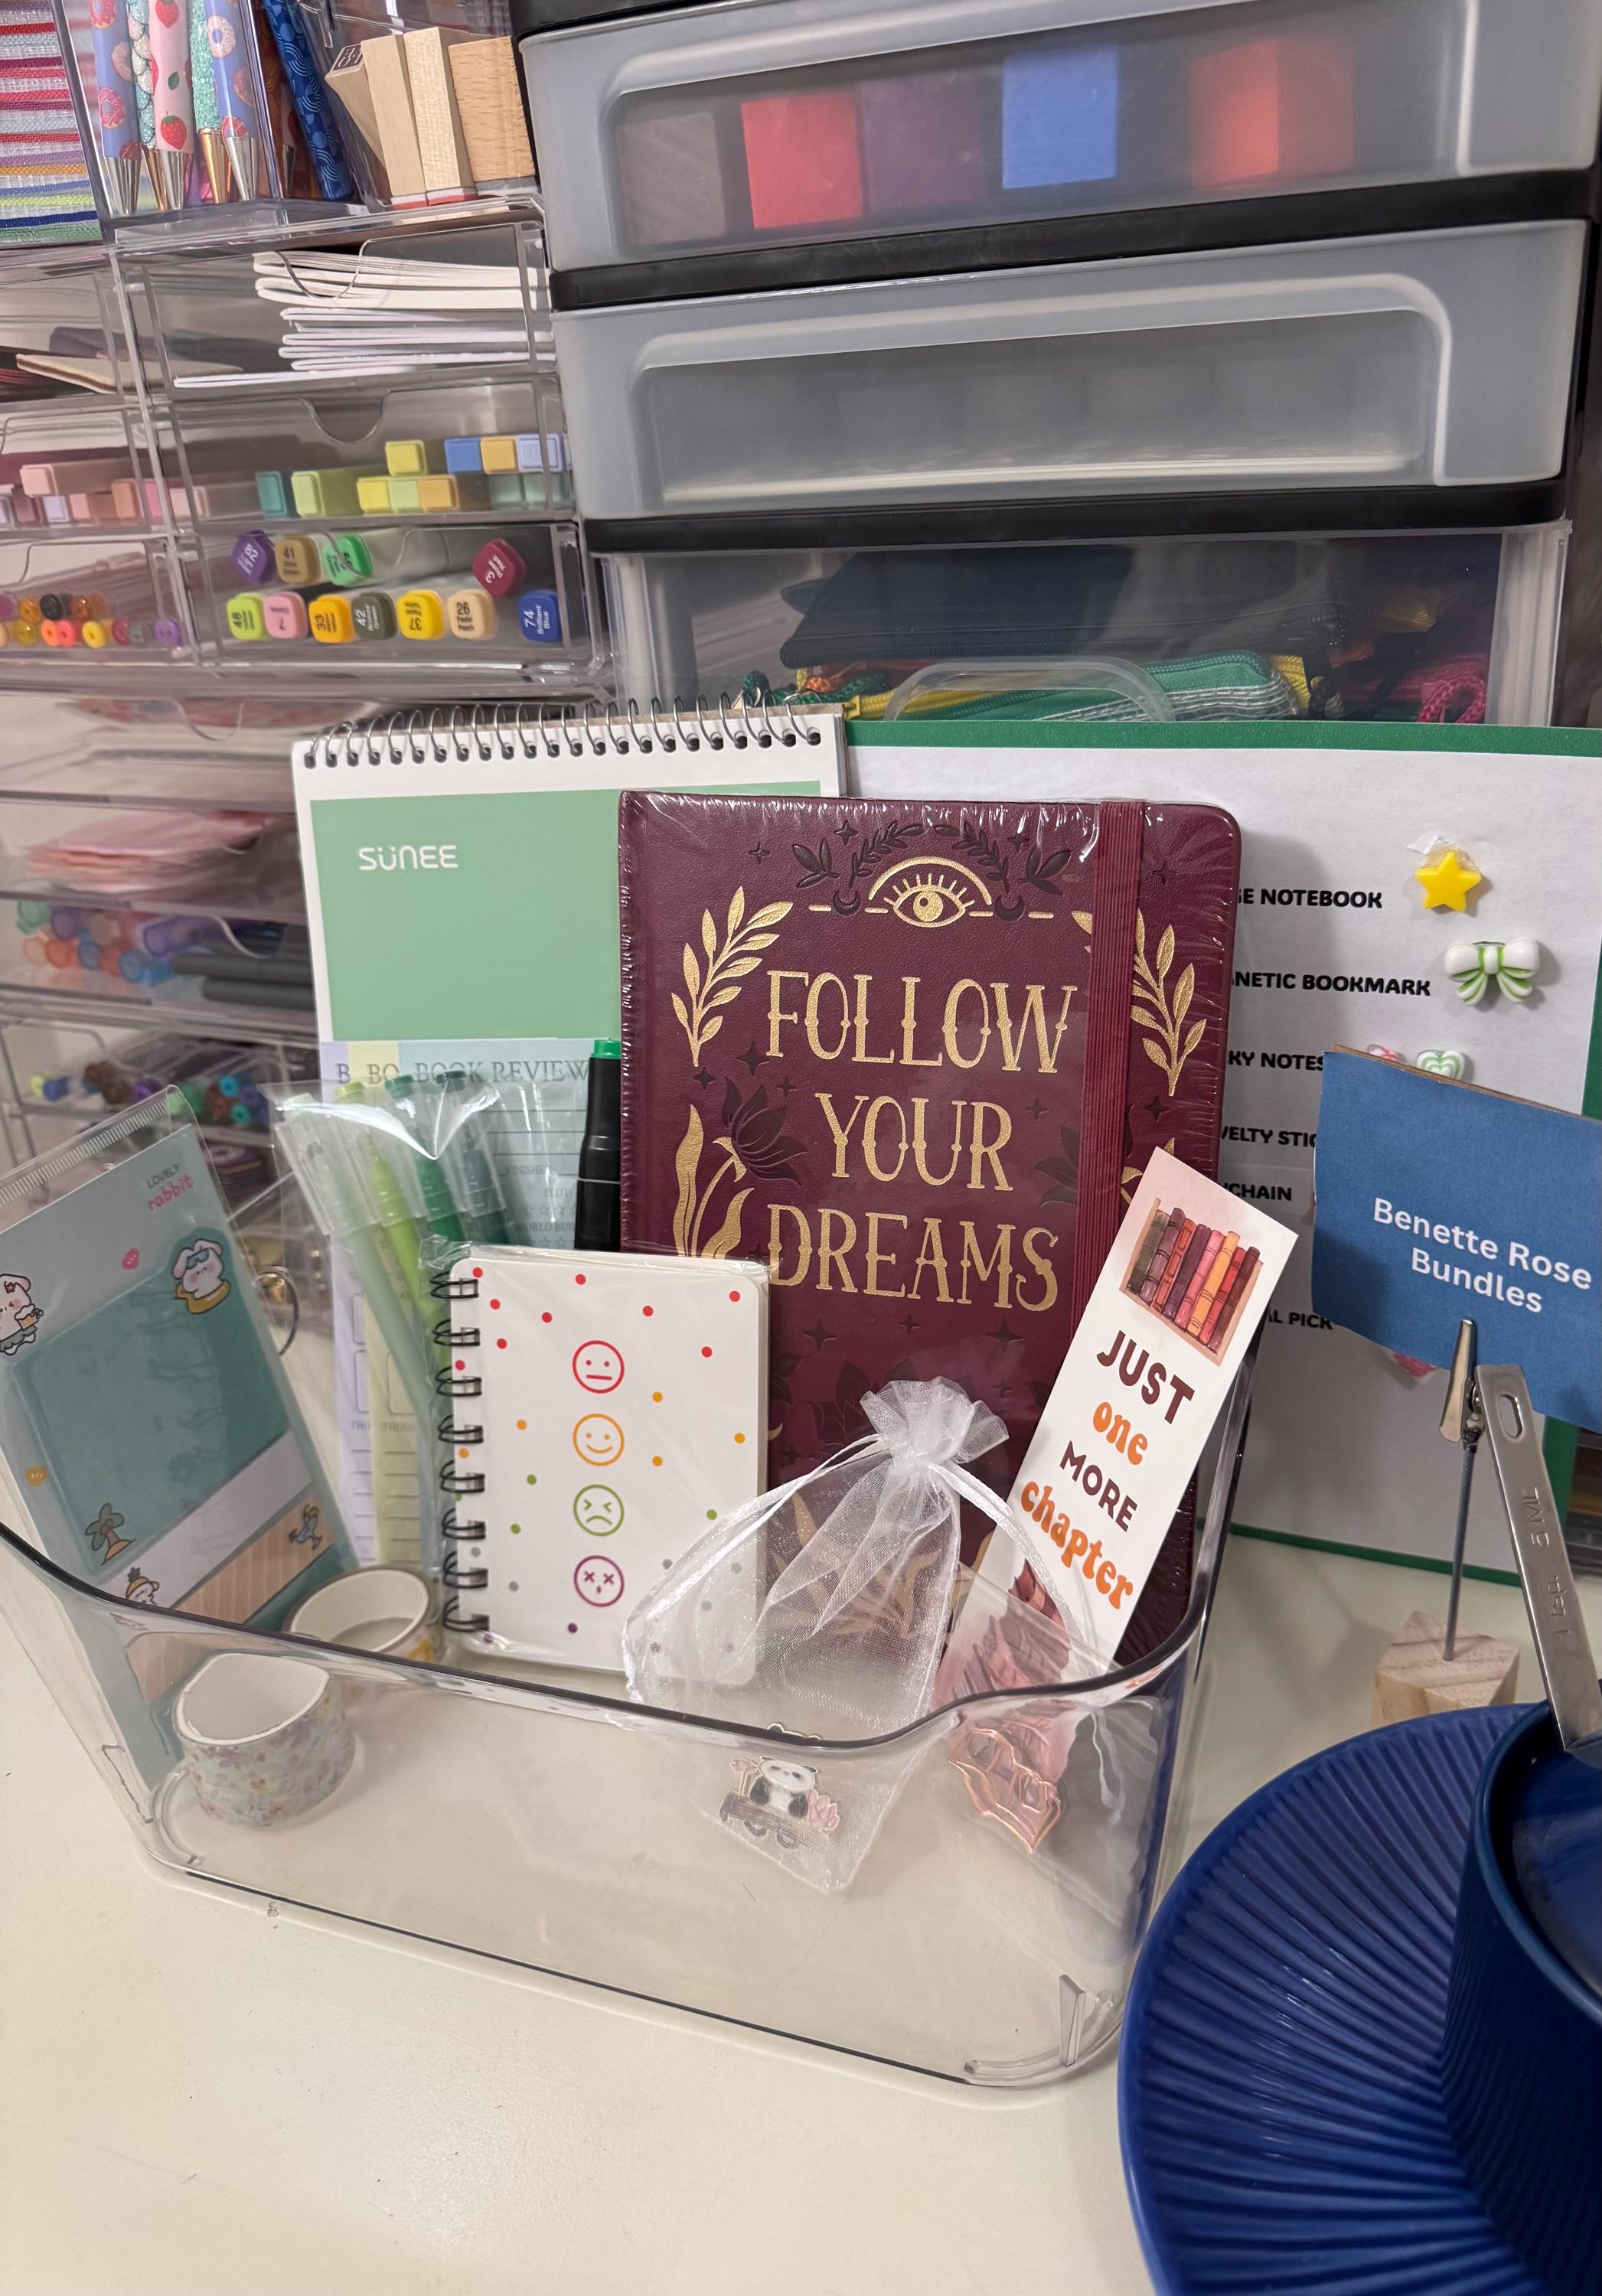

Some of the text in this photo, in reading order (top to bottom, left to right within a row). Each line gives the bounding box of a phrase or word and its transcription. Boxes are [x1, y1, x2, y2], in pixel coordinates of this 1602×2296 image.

[244, 543, 258, 563] 82
[283, 546, 295, 560] 41
[485, 570, 495, 583] 3
[355, 608, 367, 628] 42
[456, 602, 471, 615] 26
[524, 611, 536, 628] 74
[315, 615, 326, 631] 33
[409, 618, 423, 631] 37
[1261, 889, 1383, 908] NOTEBOOK
[1232, 971, 1431, 996] NETIC BOOKMARK
[765, 970, 1078, 1074] FOLLOW
[814, 1092, 1014, 1192] YOUR
[146, 1163, 181, 1189] LOVELY
[147, 1173, 195, 1212] rabbit
[1372, 1197, 1593, 1290] Benette Rose
[765, 1203, 1060, 1313] DREAMS
[1411, 1247, 1544, 1314] Bundles
[1288, 1311, 1333, 1330] PICK
[1096, 1329, 1196, 1426] JUST
[1092, 1401, 1149, 1466] one
[1059, 1440, 1139, 1532] MORE
[1520, 1486, 1545, 1525] ML
[1020, 1480, 1134, 1610] chapter
[1530, 1532, 1549, 1548] 5
